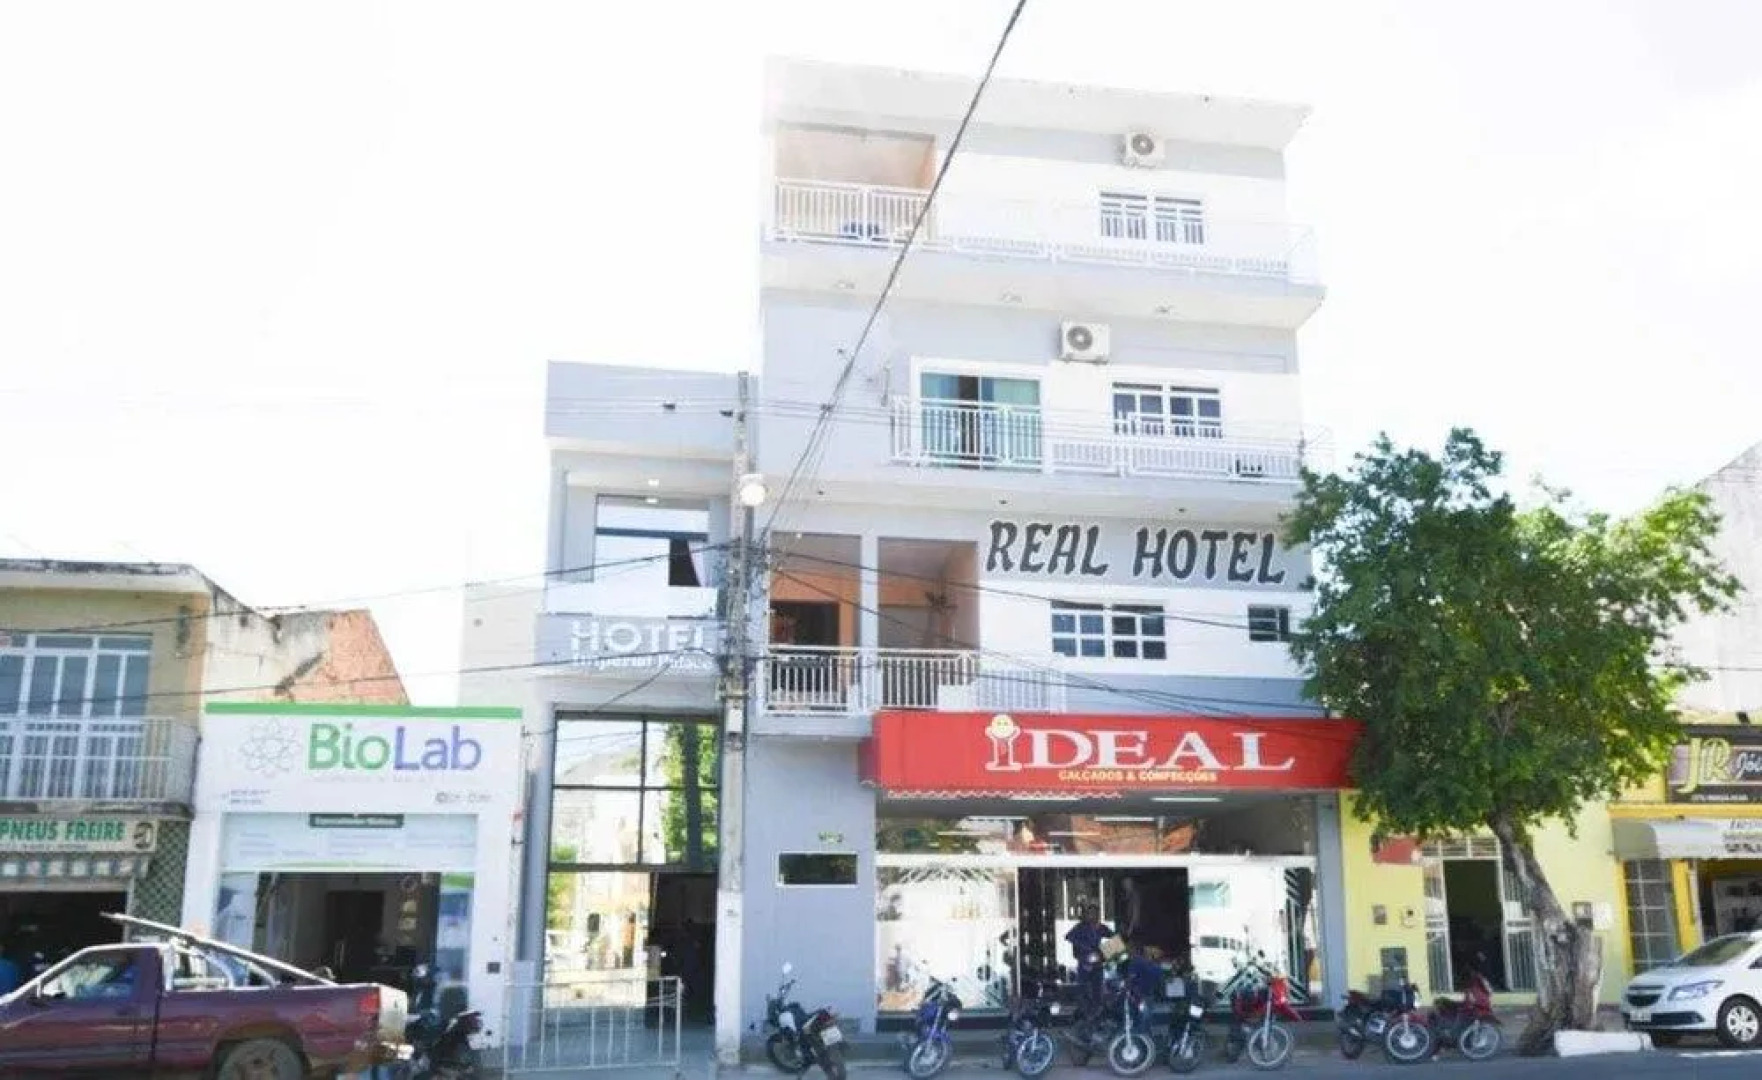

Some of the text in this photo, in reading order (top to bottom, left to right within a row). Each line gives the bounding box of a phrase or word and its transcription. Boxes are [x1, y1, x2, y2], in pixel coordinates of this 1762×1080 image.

[986, 521, 1286, 584] REAL HOTEL
[570, 620, 716, 651] HOTEL
[307, 723, 482, 771] BioLab
[0, 818, 58, 840] PNEUS
